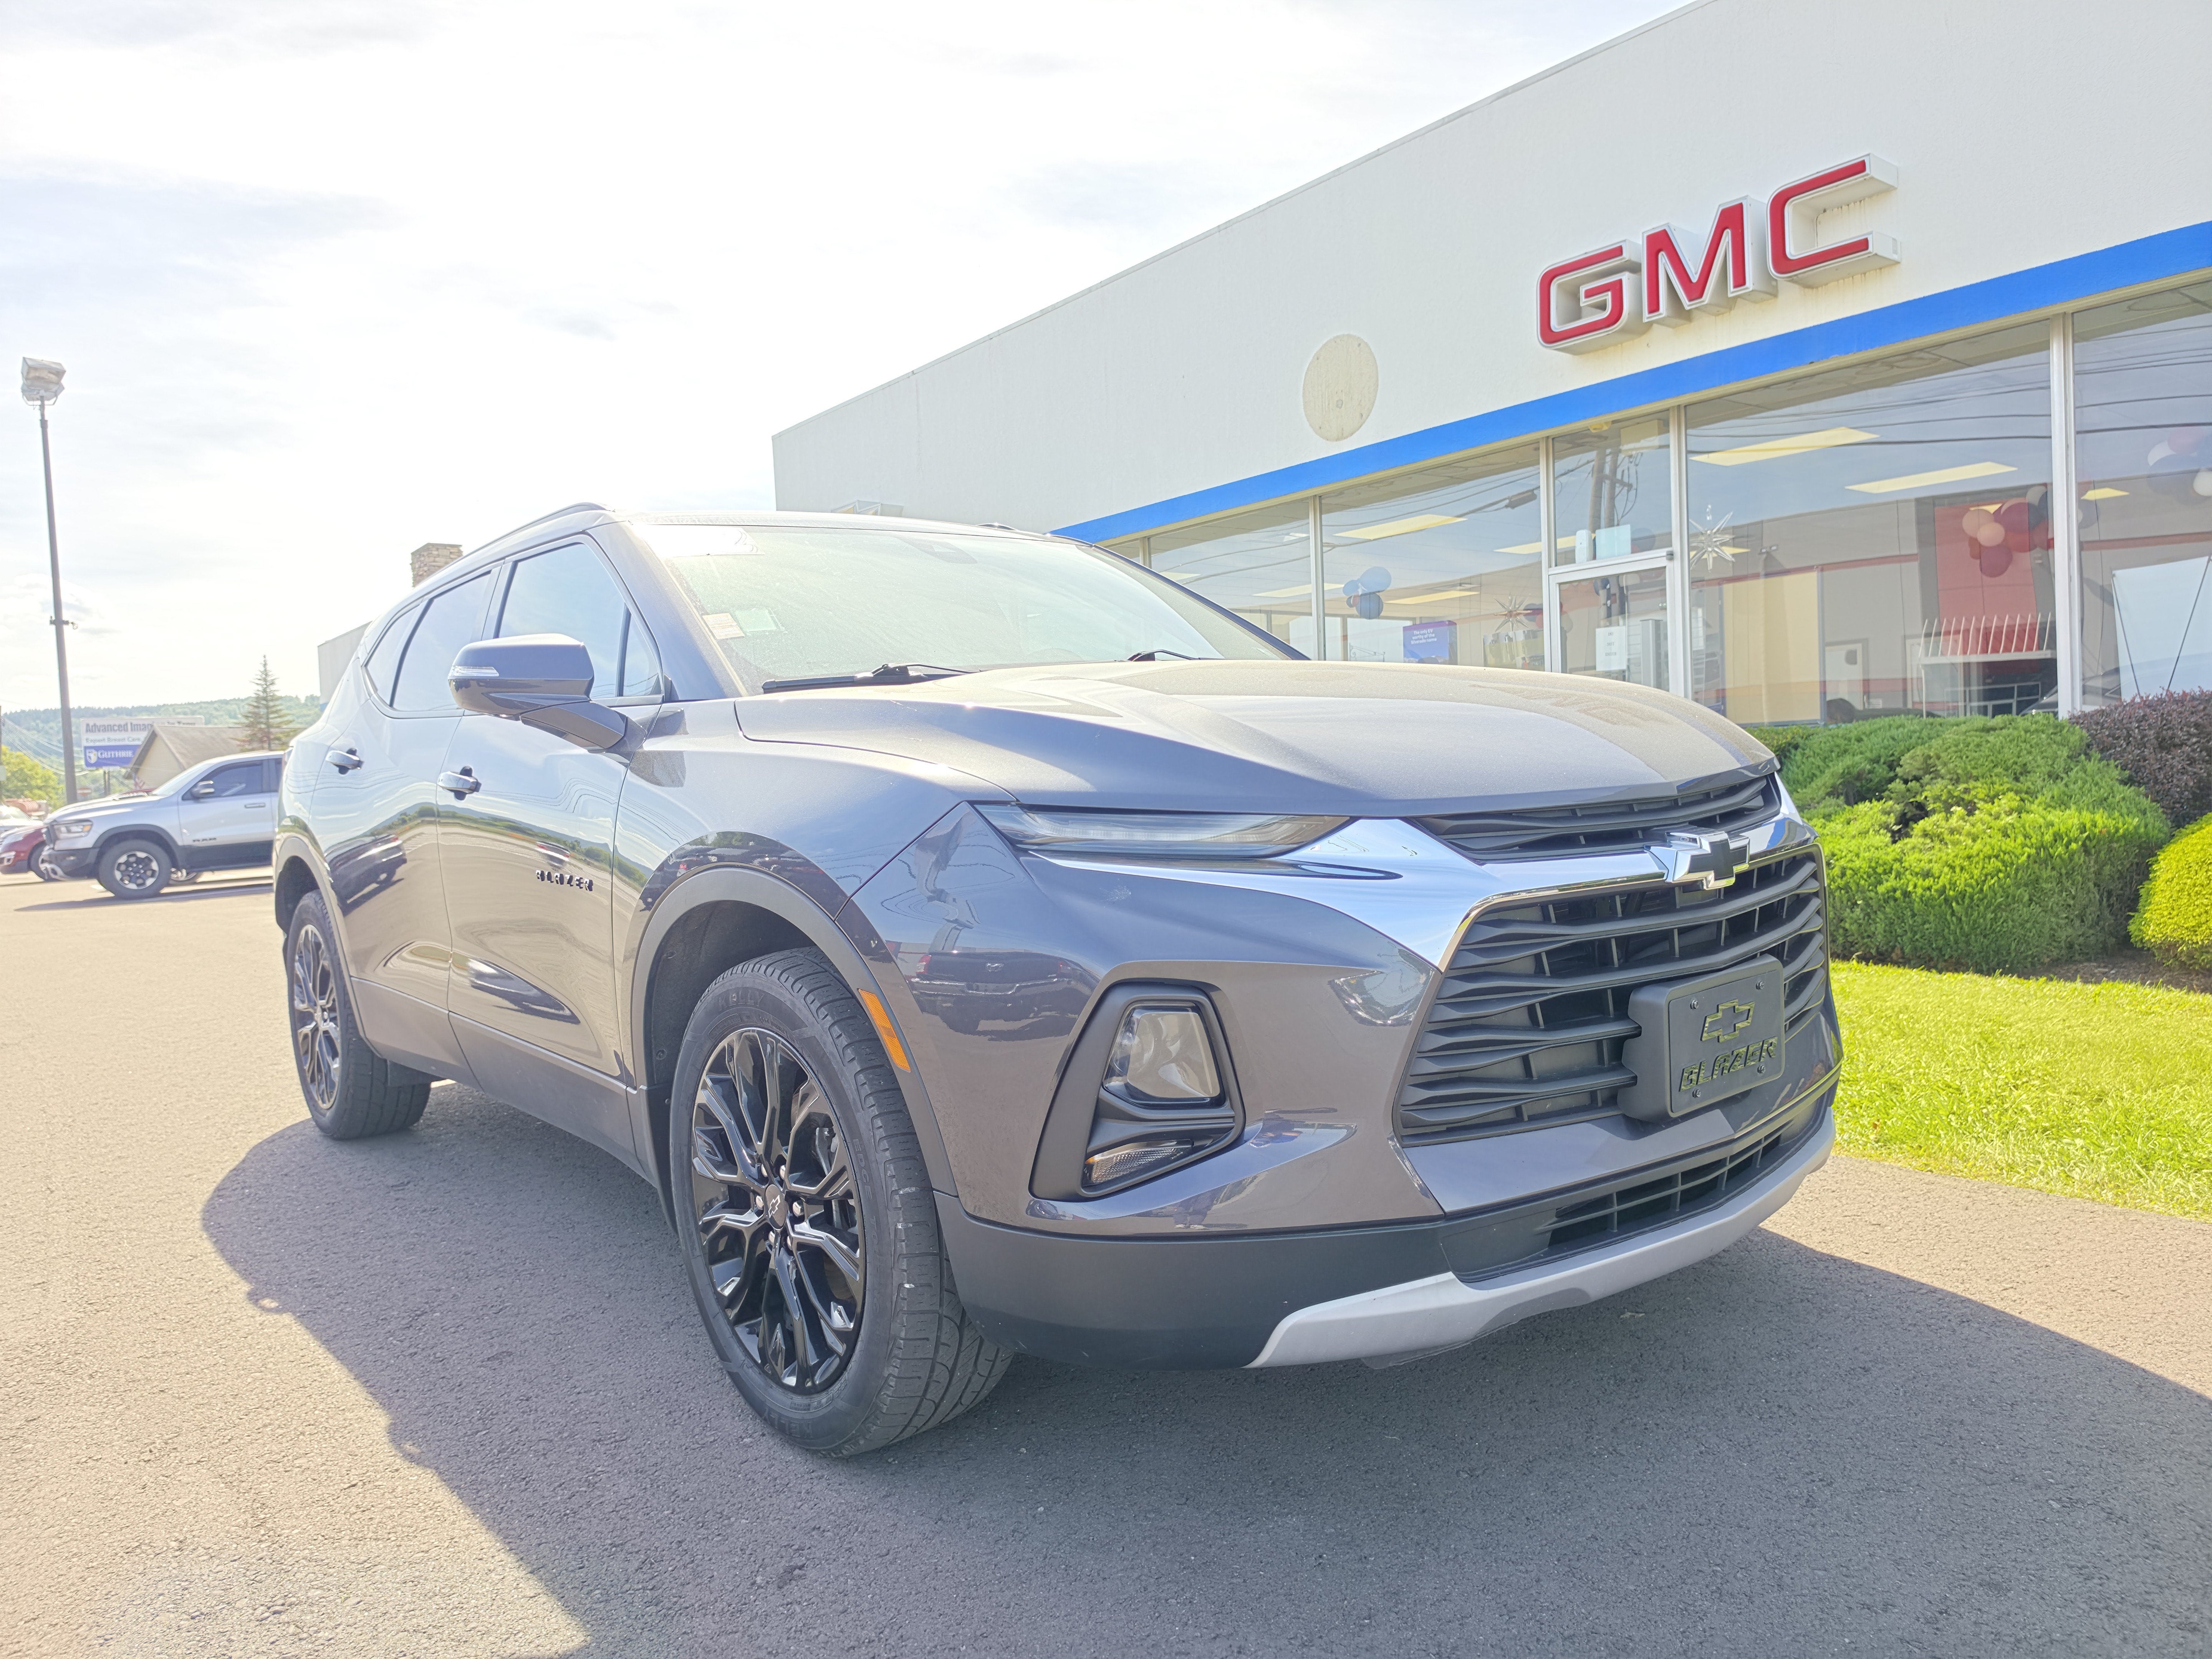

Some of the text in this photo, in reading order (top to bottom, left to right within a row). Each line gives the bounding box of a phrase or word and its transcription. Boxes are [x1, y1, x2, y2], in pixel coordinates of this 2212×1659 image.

[1537, 153, 1898, 353] GMC
[85, 722, 129, 733] Advanced
[98, 750, 134, 758] GUTHRIE
[536, 869, 594, 892] BLAZER
[718, 989, 765, 1011] KELLY
[1678, 1036, 1778, 1092] BLAZER
[853, 1139, 873, 1199] EDGE
